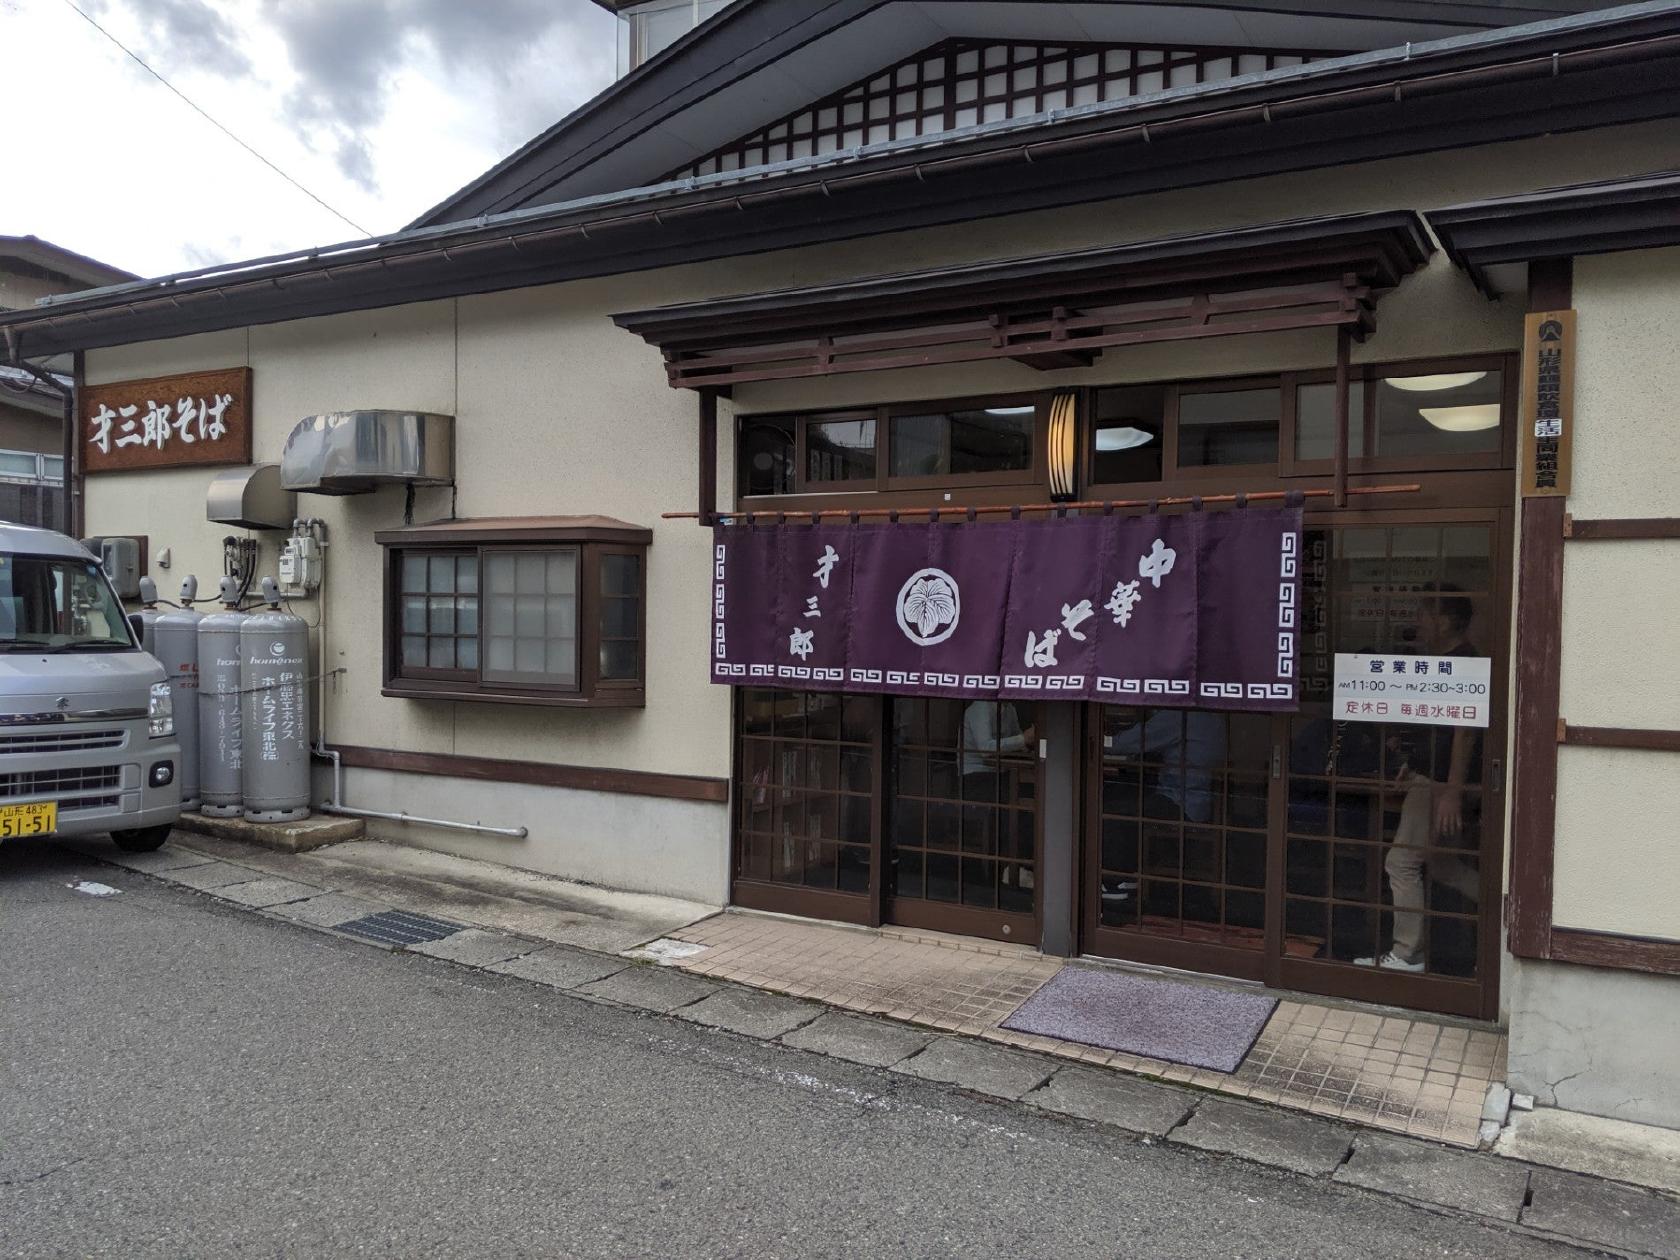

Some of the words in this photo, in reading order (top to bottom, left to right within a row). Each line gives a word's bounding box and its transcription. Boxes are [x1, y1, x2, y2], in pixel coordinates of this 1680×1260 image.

[89, 394, 233, 454] 才三郎そば
[789, 544, 840, 661] 才三郎
[1024, 538, 1177, 668] 中華そば
[1370, 660, 1453, 675] 営業時間
[1345, 701, 1388, 714] 定休日
[1401, 703, 1477, 719] 毎週水曜日
[3, 815, 51, 836] 51-51
